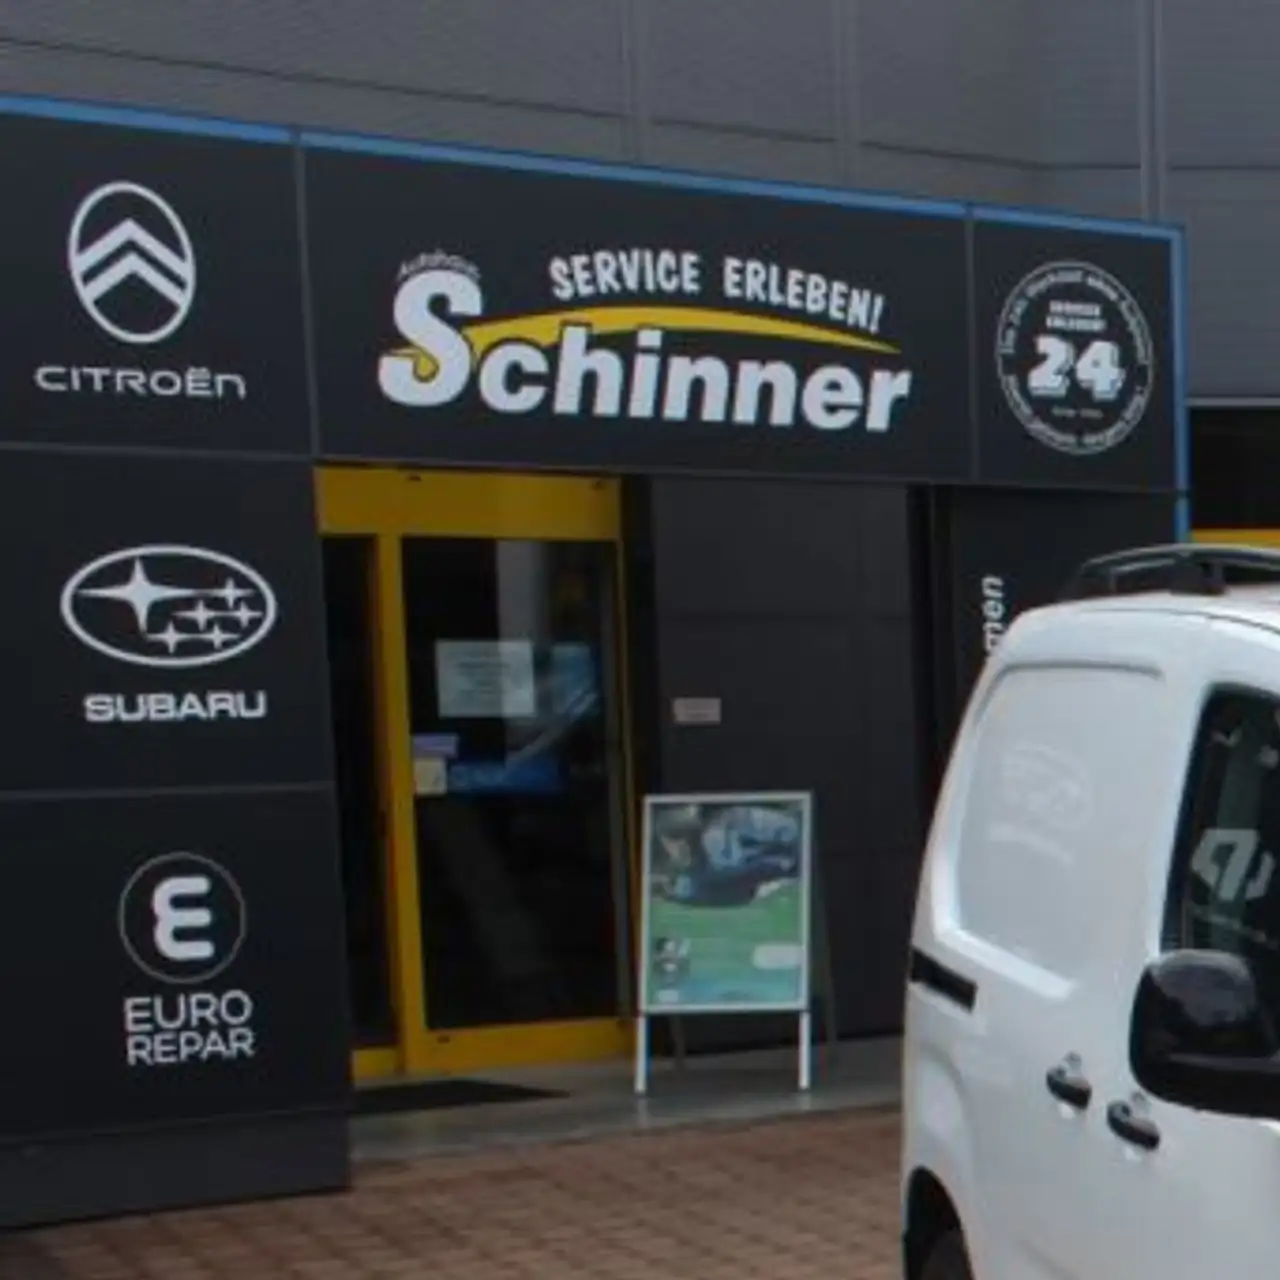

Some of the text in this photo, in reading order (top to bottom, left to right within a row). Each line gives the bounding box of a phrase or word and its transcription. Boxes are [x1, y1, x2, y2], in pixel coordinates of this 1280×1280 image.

[549, 247, 884, 335] SERVICE ERLEBEN!
[377, 269, 912, 432] Schinner
[1027, 335, 1127, 402] 24
[84, 691, 267, 722] SUBARU
[124, 990, 253, 1032] EURO
[127, 1027, 256, 1065] REPAR
